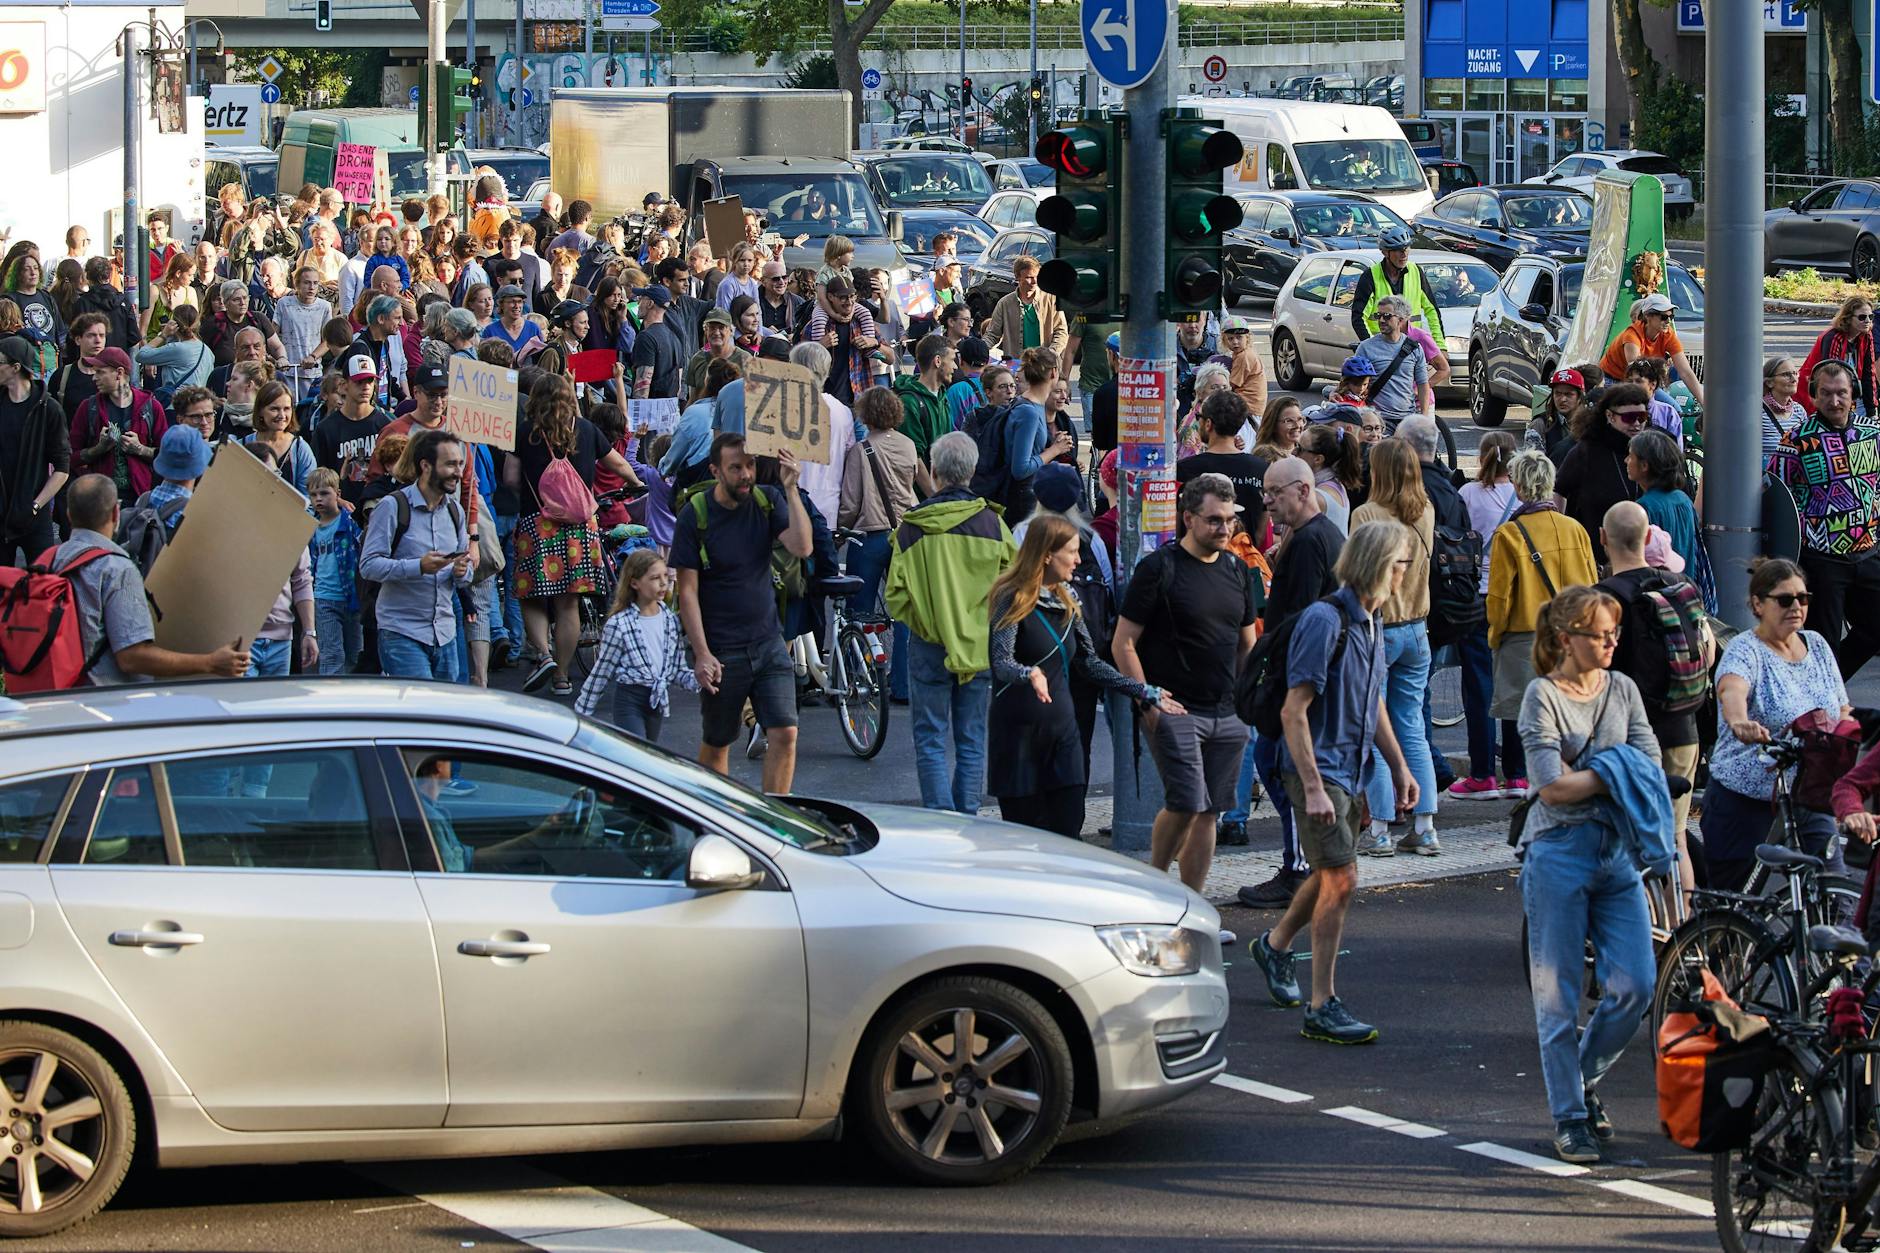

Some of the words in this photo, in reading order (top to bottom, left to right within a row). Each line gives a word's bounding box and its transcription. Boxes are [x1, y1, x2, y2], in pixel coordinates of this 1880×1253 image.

[1467, 49, 1501, 60] NACHT-
[1467, 61, 1502, 73] ZUGANG
[342, 143, 357, 153] DAS
[336, 182, 371, 198] OHREN
[454, 363, 469, 393] A
[472, 370, 497, 400] 100
[1134, 387, 1160, 399] KIEZ
[747, 373, 821, 447] ZU!
[448, 405, 513, 443] RADWEG
[1145, 492, 1167, 502] YOUR
